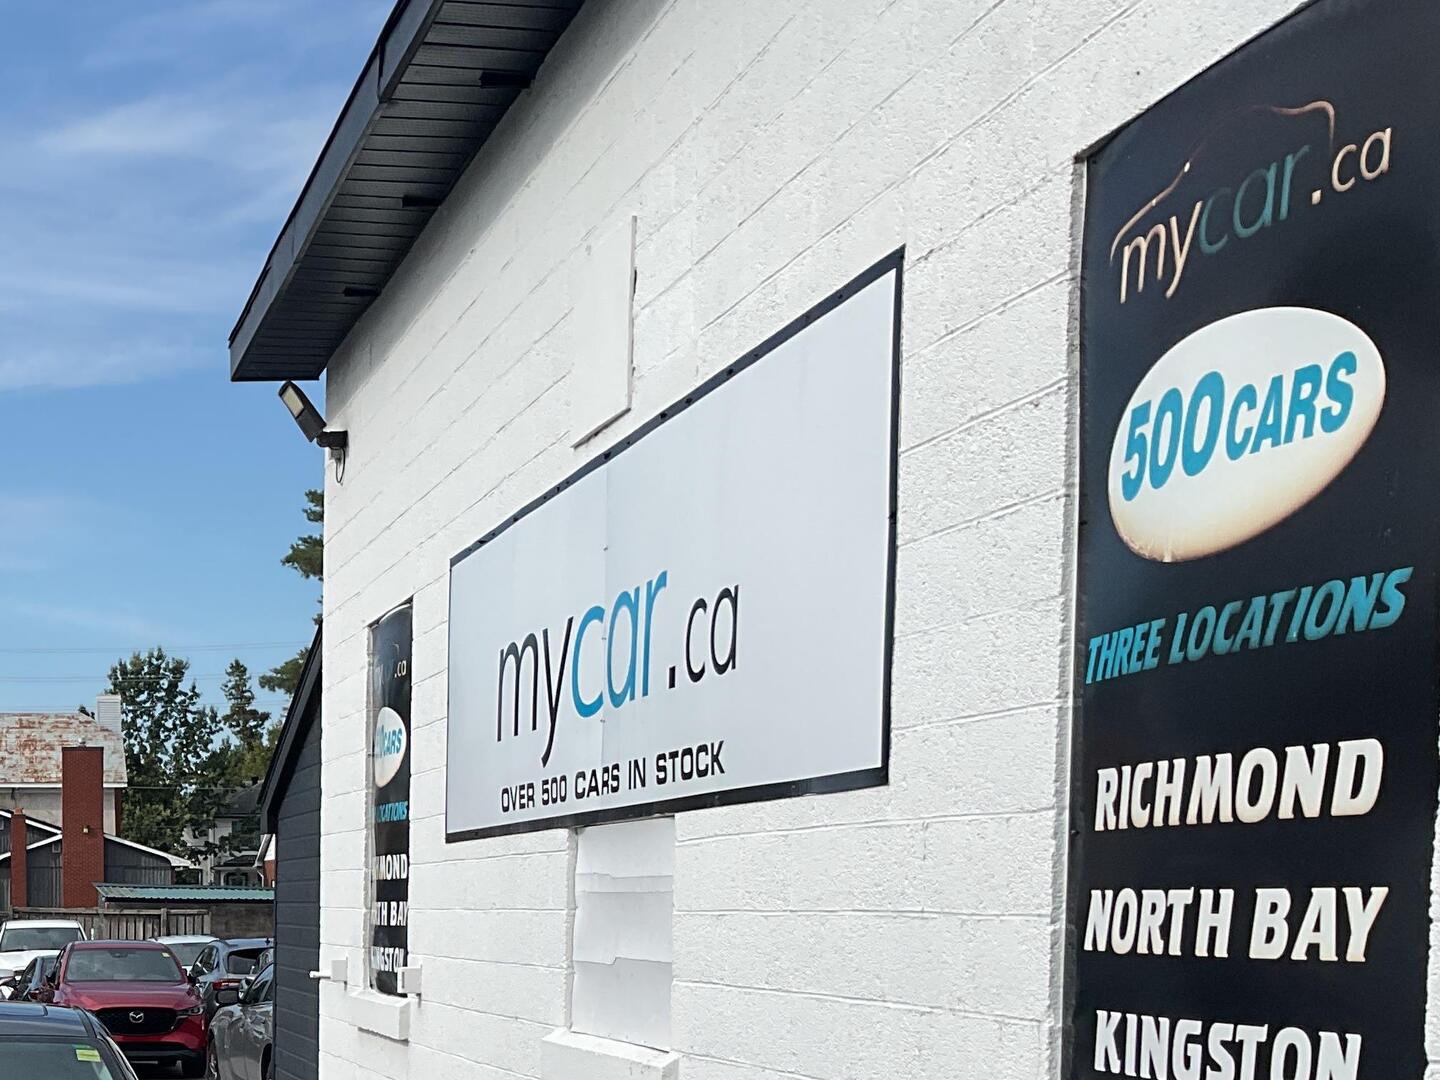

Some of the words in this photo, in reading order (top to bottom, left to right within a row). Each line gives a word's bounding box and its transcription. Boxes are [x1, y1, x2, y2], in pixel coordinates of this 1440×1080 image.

[495, 570, 740, 768] mycar.ca
[1085, 617, 1163, 685] THREE
[1168, 567, 1414, 665] LOCATIONS
[501, 781, 535, 813] OVER
[541, 774, 567, 806] 500
[574, 763, 621, 798] CARS
[628, 757, 647, 791] IN
[656, 740, 726, 785] STOCK
[1094, 738, 1385, 832] RICHMOND
[1083, 887, 1235, 958] NORTH
[1249, 886, 1390, 962] BAY
